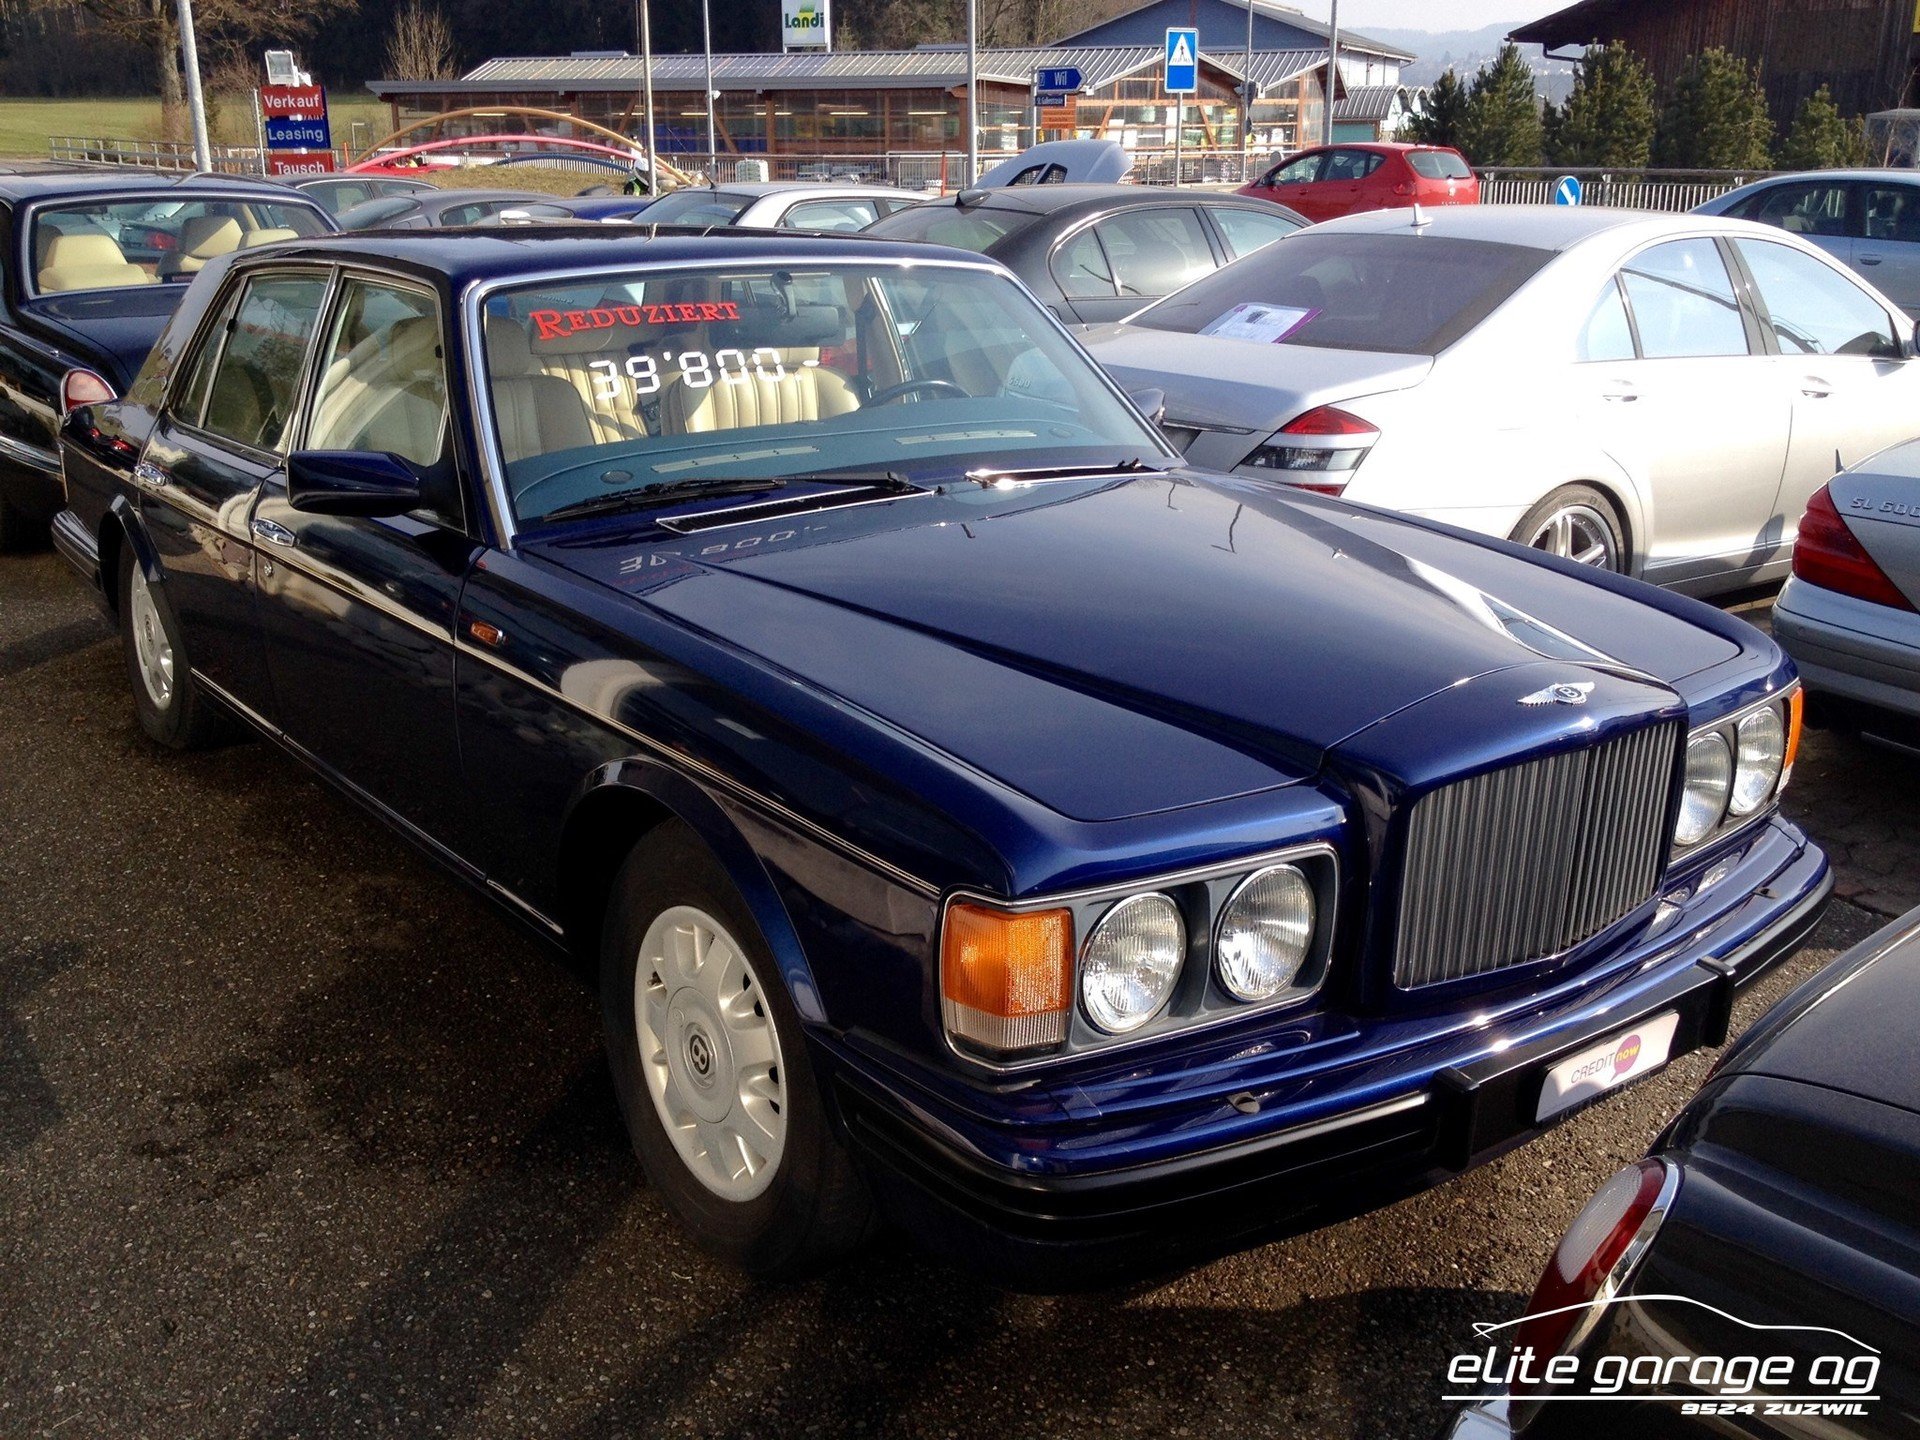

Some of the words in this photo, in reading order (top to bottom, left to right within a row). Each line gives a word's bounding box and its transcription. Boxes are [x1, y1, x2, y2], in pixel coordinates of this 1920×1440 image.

[785, 12, 824, 28] Landi
[1054, 71, 1067, 86] Wil
[264, 95, 319, 108] Verkauf
[268, 127, 324, 142] Leasing
[275, 161, 325, 175] Tausch
[1851, 497, 1873, 510] SL
